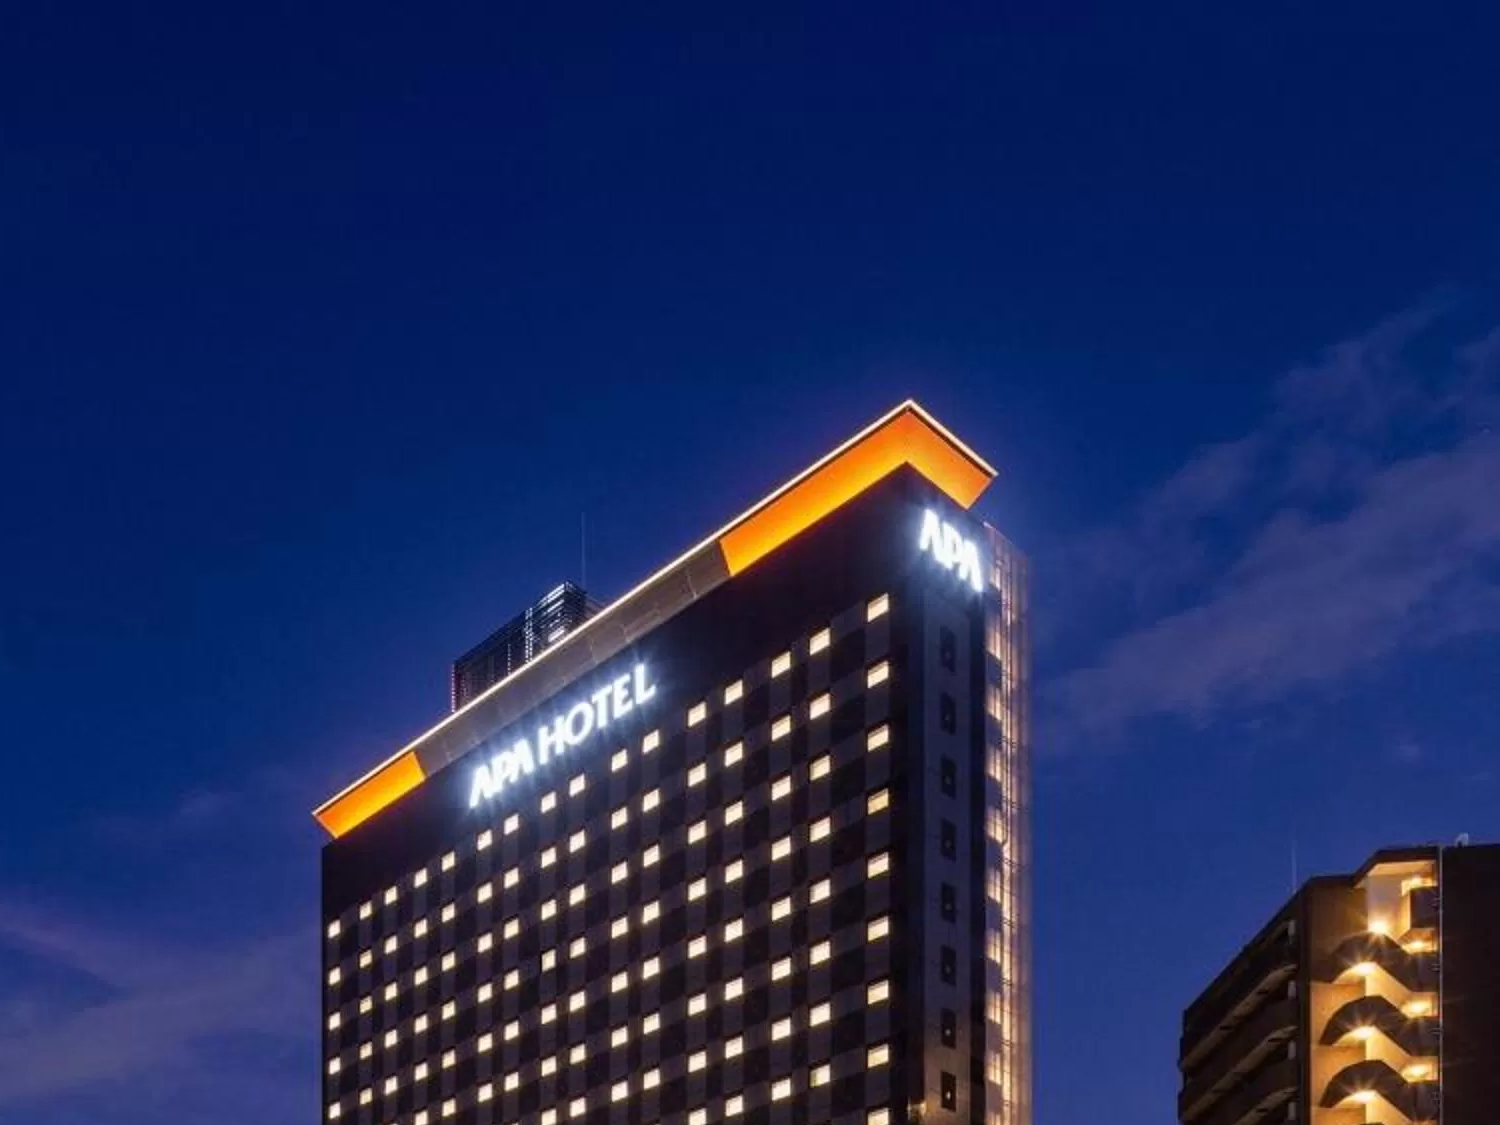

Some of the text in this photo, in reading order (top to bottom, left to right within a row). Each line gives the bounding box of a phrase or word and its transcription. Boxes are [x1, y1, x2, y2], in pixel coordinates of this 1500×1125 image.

[919, 508, 983, 593] APA
[469, 662, 657, 809] APA HOTEL
